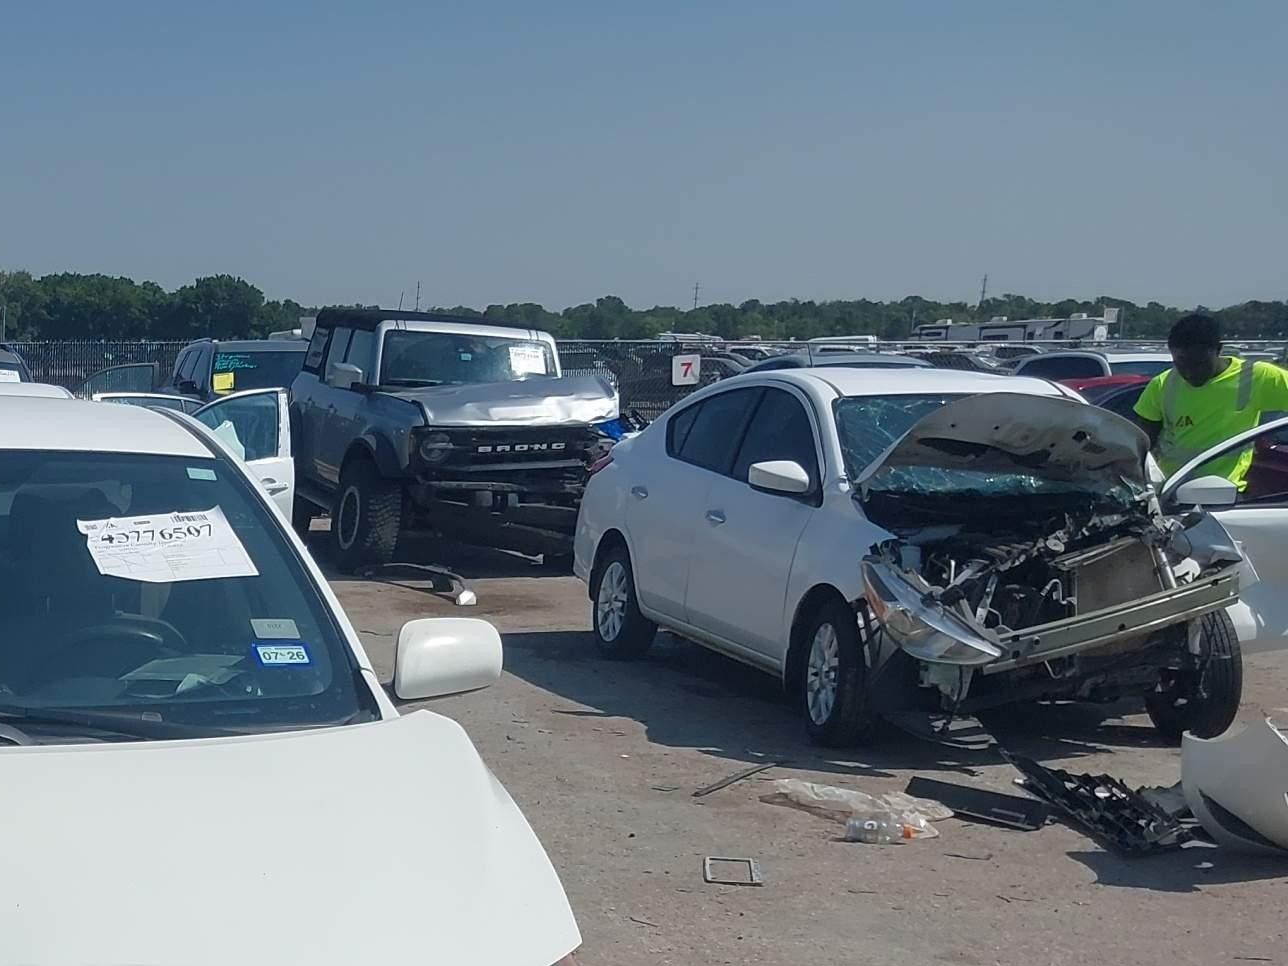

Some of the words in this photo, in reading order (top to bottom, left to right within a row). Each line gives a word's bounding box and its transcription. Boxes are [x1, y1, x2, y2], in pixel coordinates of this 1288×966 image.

[679, 362, 694, 378] 7
[262, 650, 279, 661] 07
[286, 650, 305, 661] 26
